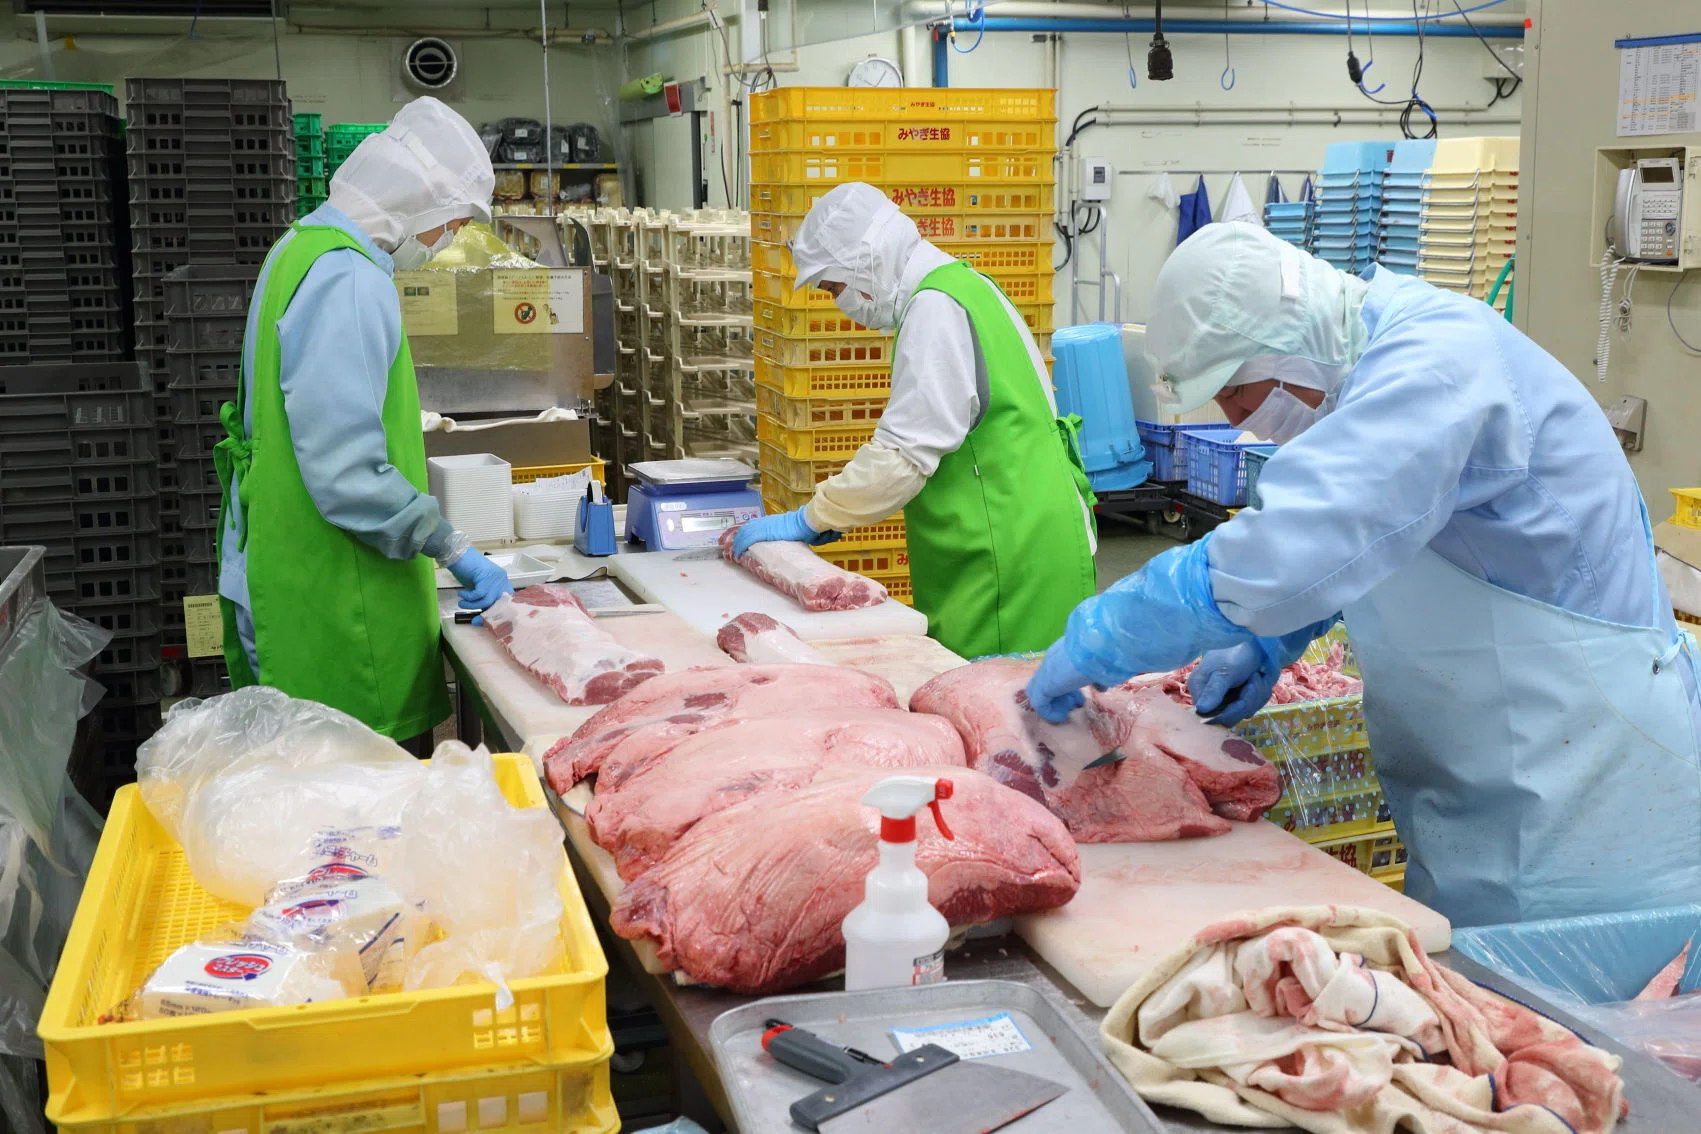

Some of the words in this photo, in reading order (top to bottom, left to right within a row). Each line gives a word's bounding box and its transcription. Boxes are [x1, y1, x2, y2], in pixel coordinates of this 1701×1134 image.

[897, 127, 951, 141] みやぎ生協
[892, 187, 956, 207] みやぎ生協
[916, 217, 955, 237] ぎ生協
